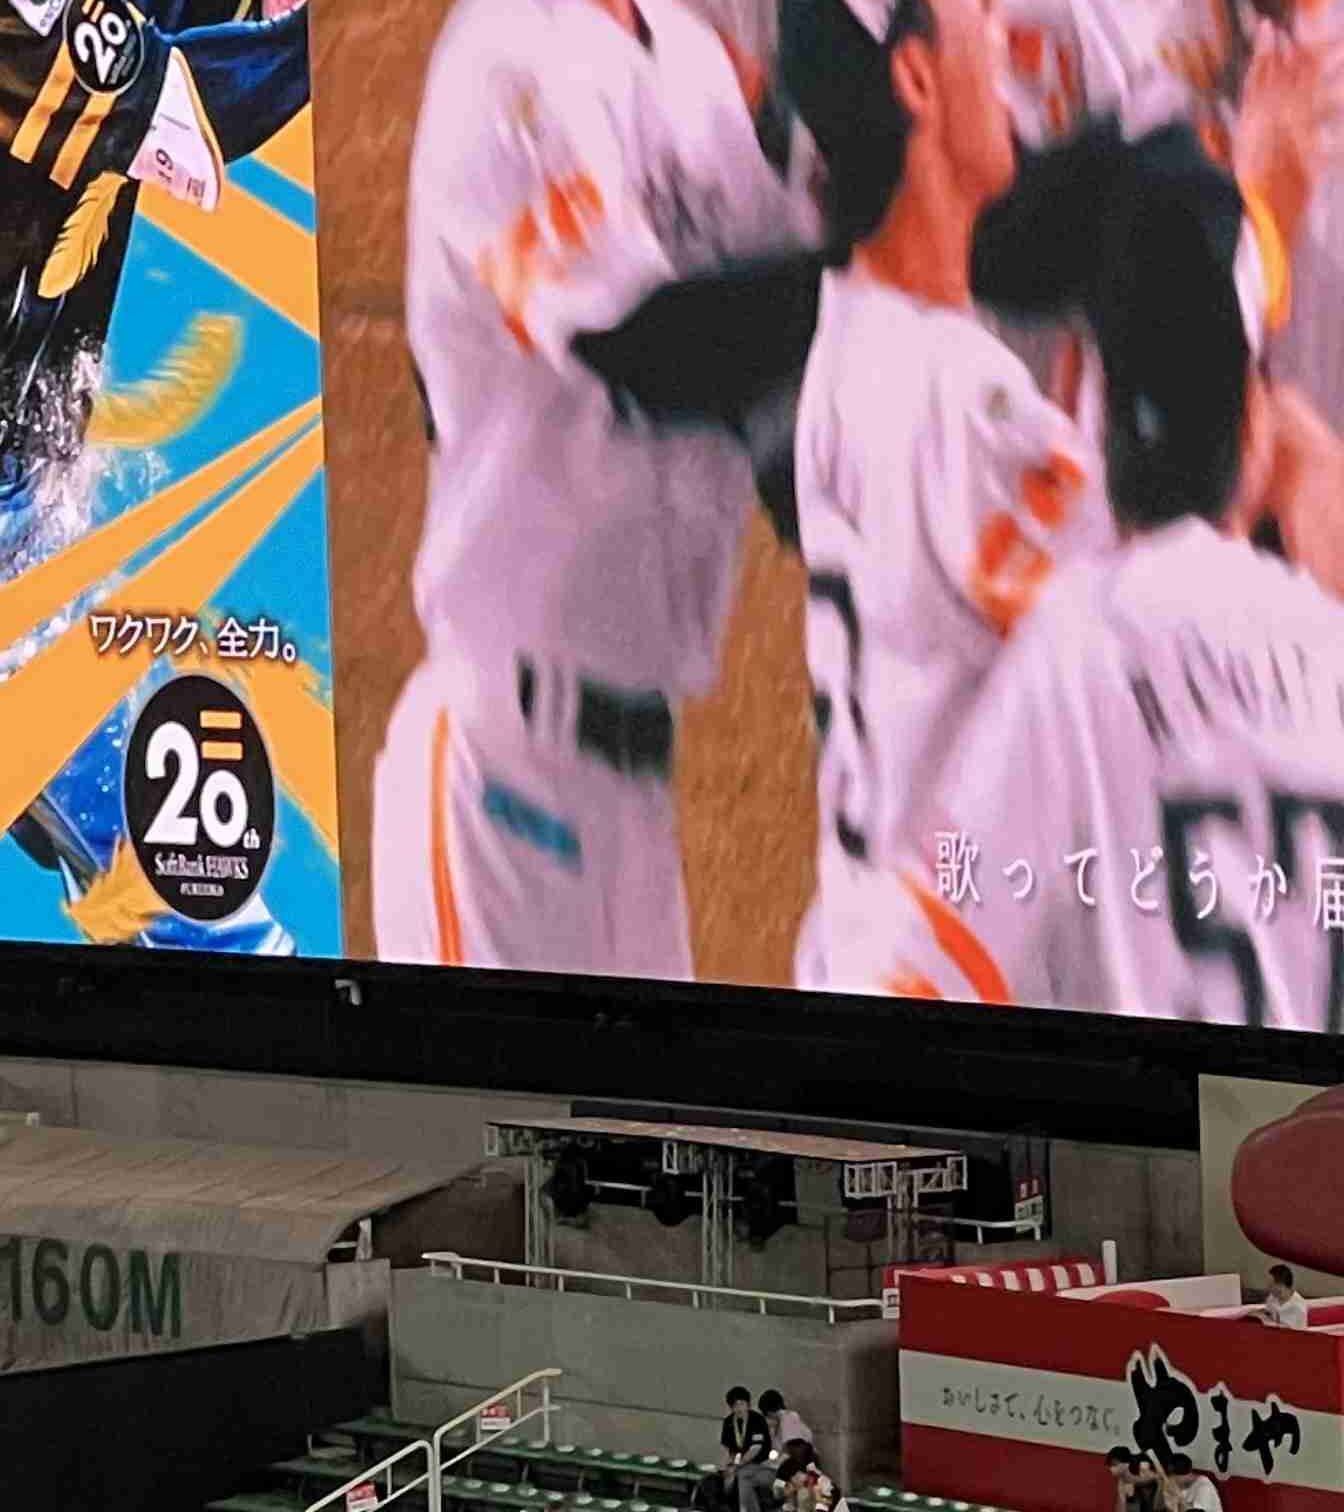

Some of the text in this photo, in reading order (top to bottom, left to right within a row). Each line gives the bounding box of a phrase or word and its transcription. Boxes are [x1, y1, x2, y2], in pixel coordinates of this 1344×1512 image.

[89, 614, 297, 663] ワクワク、全力。
[1131, 1356, 1301, 1476] やまや
